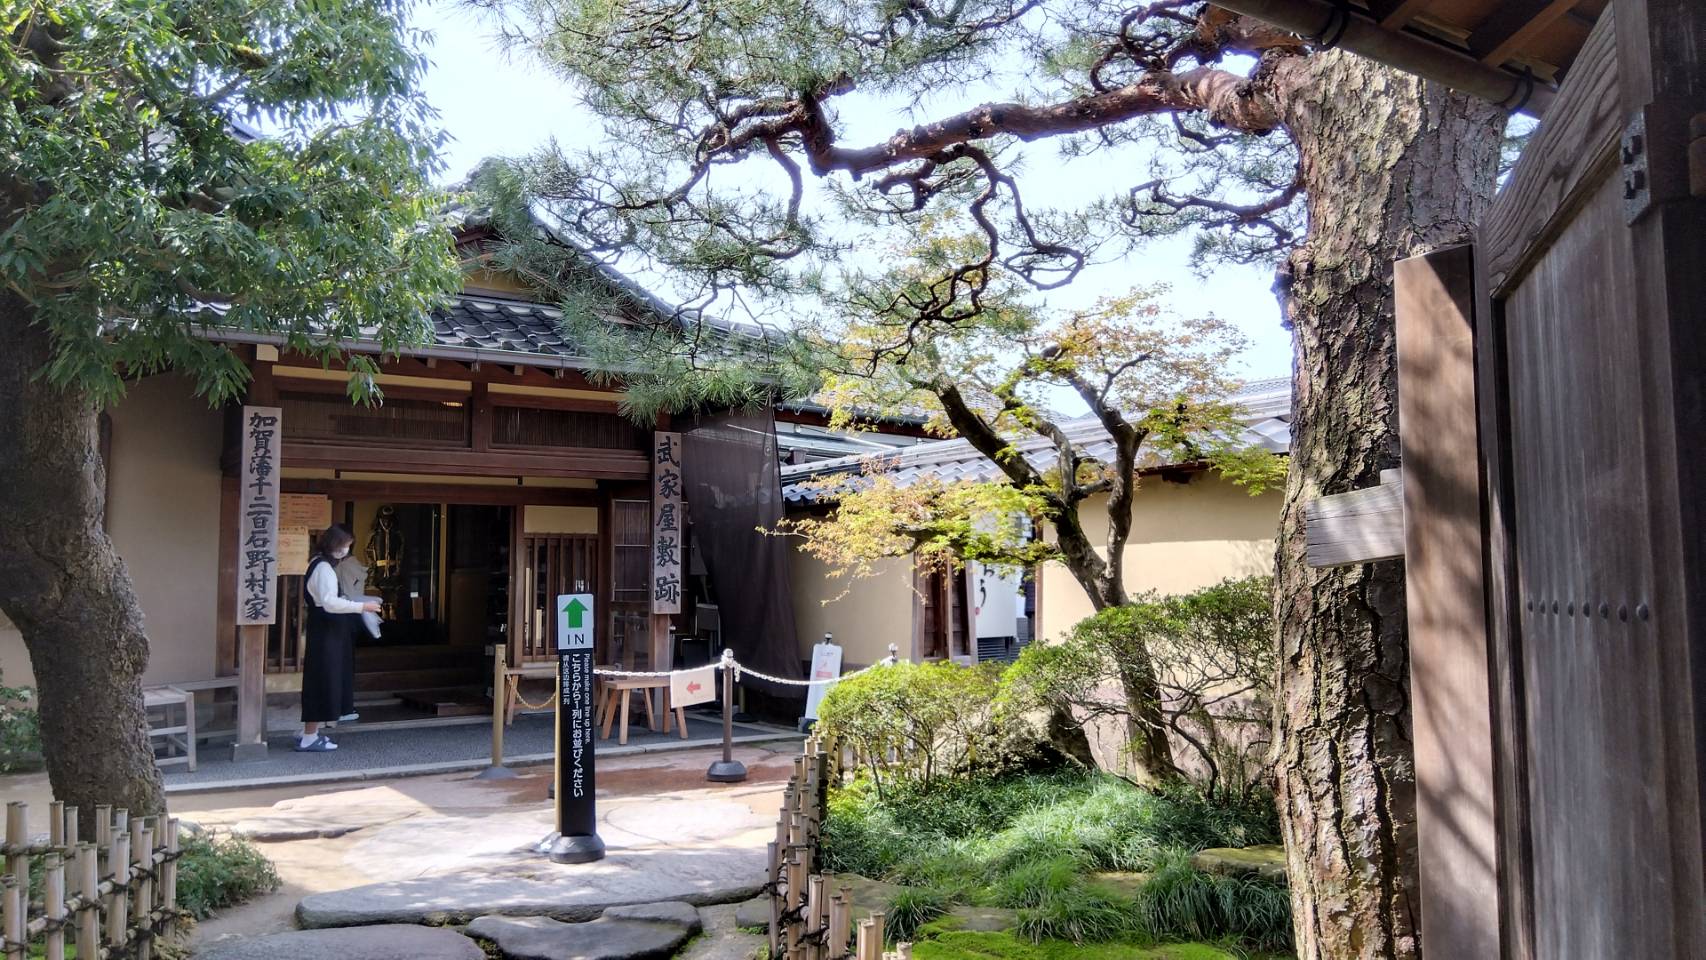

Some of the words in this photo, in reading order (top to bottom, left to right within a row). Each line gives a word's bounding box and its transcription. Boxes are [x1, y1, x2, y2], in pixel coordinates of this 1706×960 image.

[244, 411, 278, 621] 加賀藩千二百石野村家
[654, 435, 681, 605] 武家屋敷跡
[567, 633, 585, 646] IN
[583, 653, 591, 674] Please
[583, 674, 591, 692] make
[571, 653, 584, 798] こちらから1列にお並びください
[583, 718, 590, 728] up
